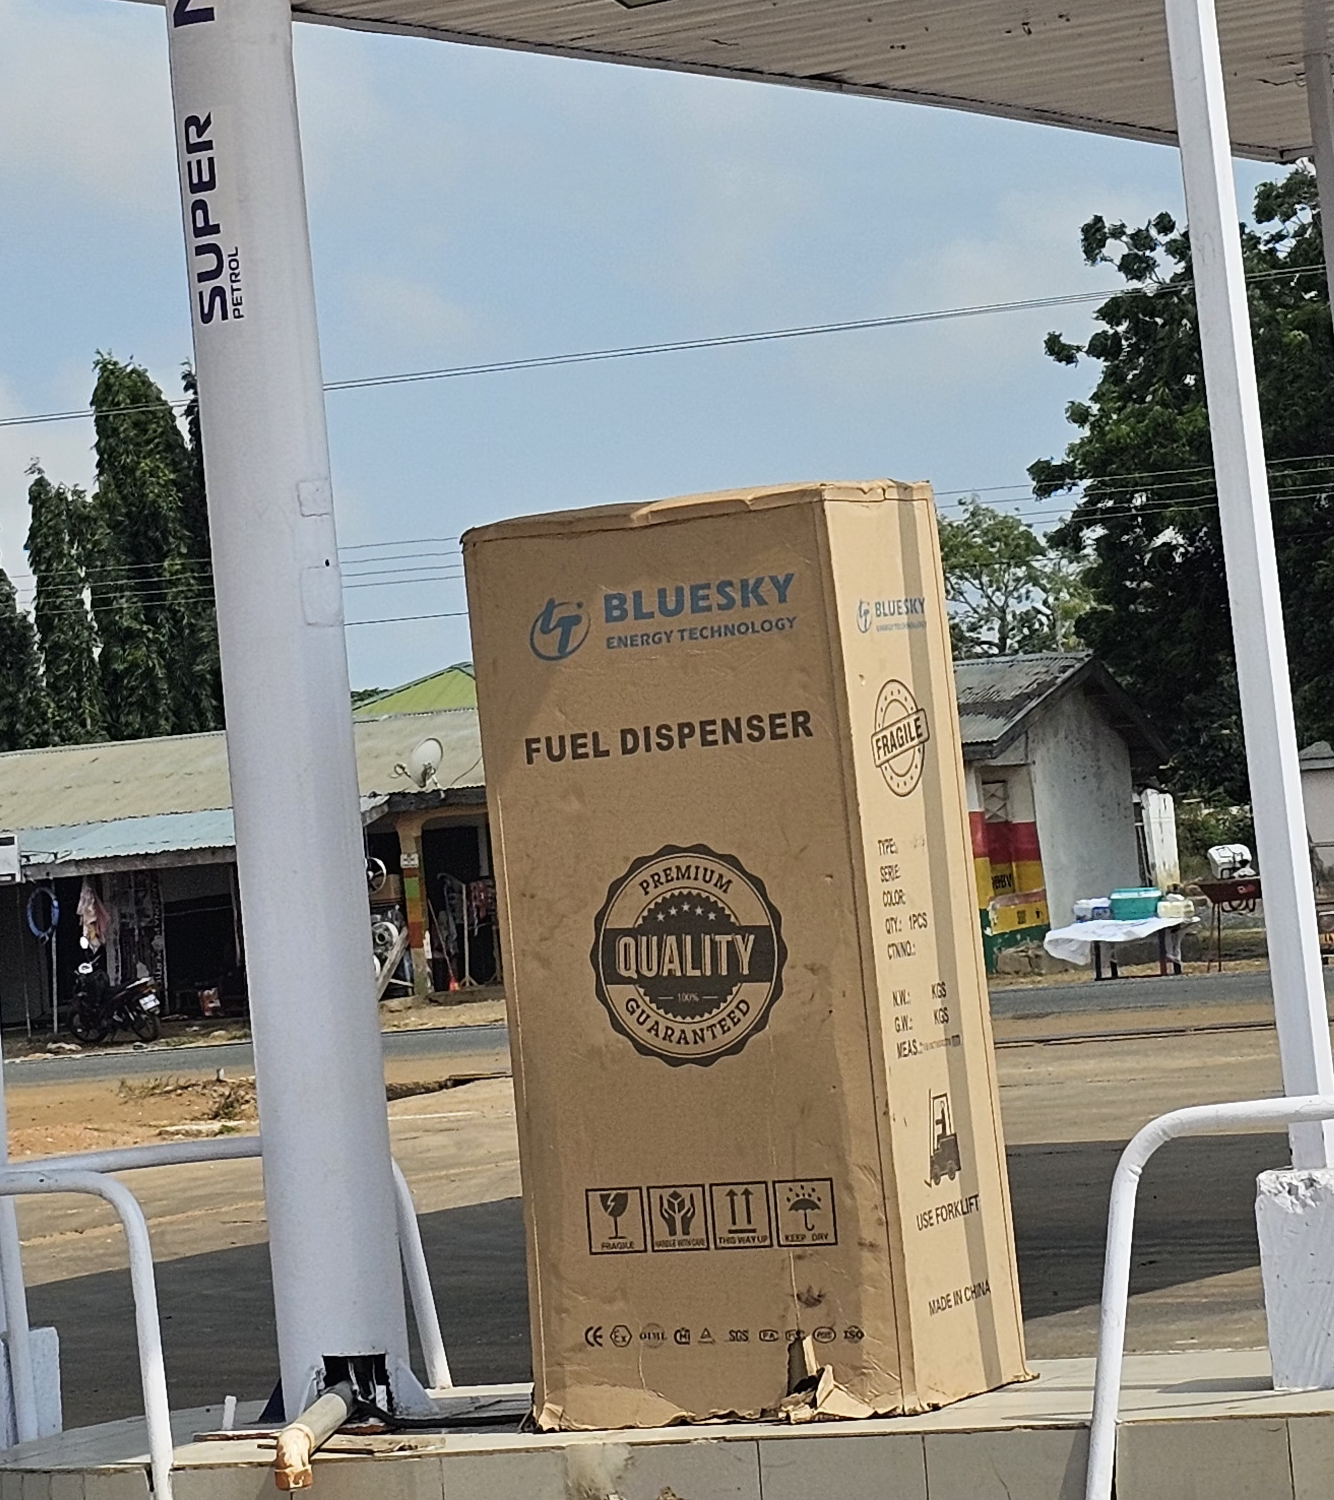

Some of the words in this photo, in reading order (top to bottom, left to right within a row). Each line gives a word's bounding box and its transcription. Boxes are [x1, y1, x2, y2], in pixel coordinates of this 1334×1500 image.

[184, 111, 229, 326] SUPER
[227, 246, 244, 320] PETROL
[604, 572, 796, 625] BLUESKY
[875, 597, 925, 618] BLUESKY
[605, 628, 675, 651] ENERGY
[679, 615, 798, 643] TECHNOLOGY
[525, 731, 611, 765] FUEL
[620, 709, 814, 756] DISPENSER
[875, 715, 924, 761] FRAGILE
[638, 864, 734, 896] PREMIUM
[617, 933, 755, 980] QUALITY
[676, 992, 700, 1003] 100%
[931, 981, 947, 999] KGS
[625, 997, 751, 1046] GUARANTEED
[933, 1006, 949, 1026] KGS
[916, 1208, 935, 1232] USE
[934, 1193, 980, 1224] FORKLIFT
[601, 1240, 635, 1250] FRAGILE
[718, 1236, 738, 1245] THIS
[738, 1235, 758, 1244] WAY
[784, 1234, 807, 1243] KEEP
[811, 1232, 829, 1242] DRY
[928, 1295, 953, 1317] MADE
[953, 1290, 964, 1307] IN
[963, 1279, 991, 1302] CHINA
